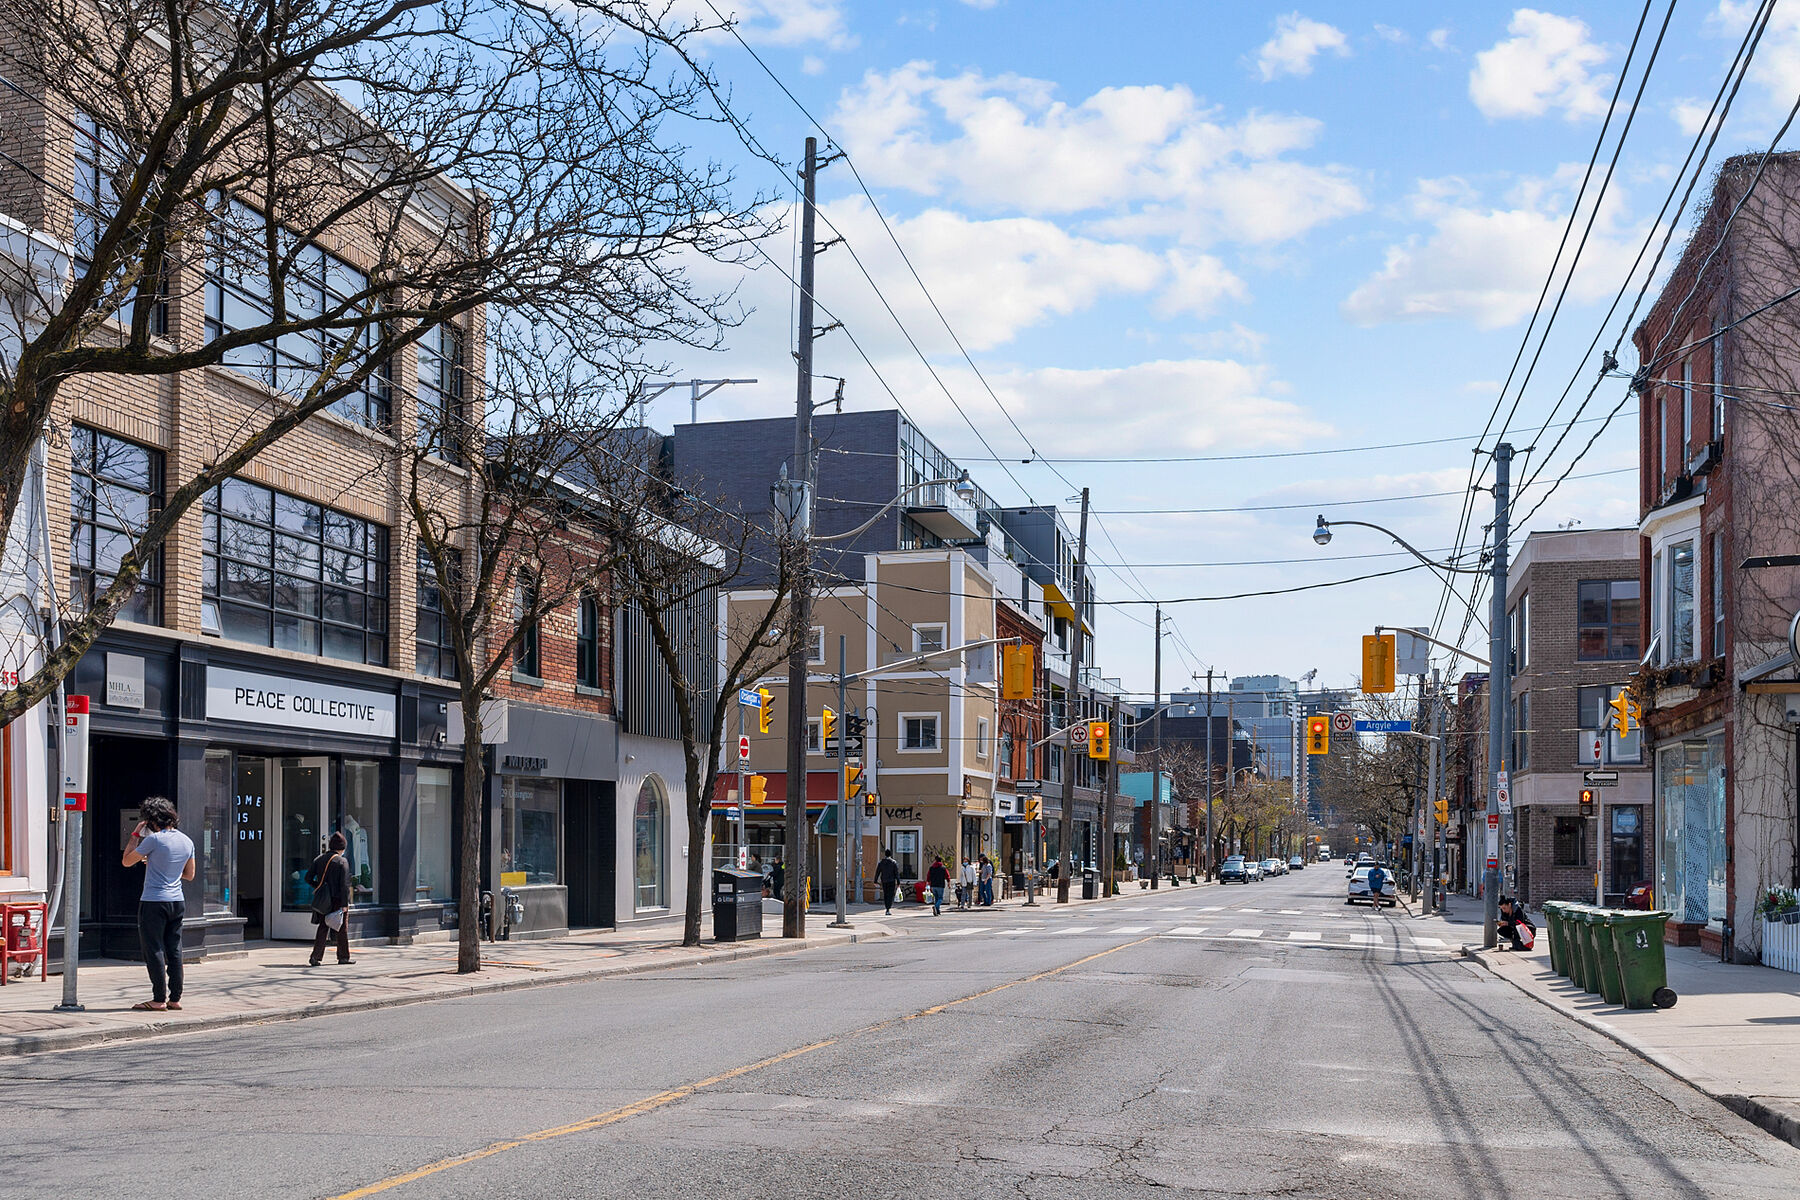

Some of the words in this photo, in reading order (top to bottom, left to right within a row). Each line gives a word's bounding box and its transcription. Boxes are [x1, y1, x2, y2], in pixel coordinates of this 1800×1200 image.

[235, 687, 286, 711] PEACE
[293, 695, 375, 721] COLLECTIVE
[1366, 721, 1392, 731] Argyle
[237, 812, 249, 823] IS
